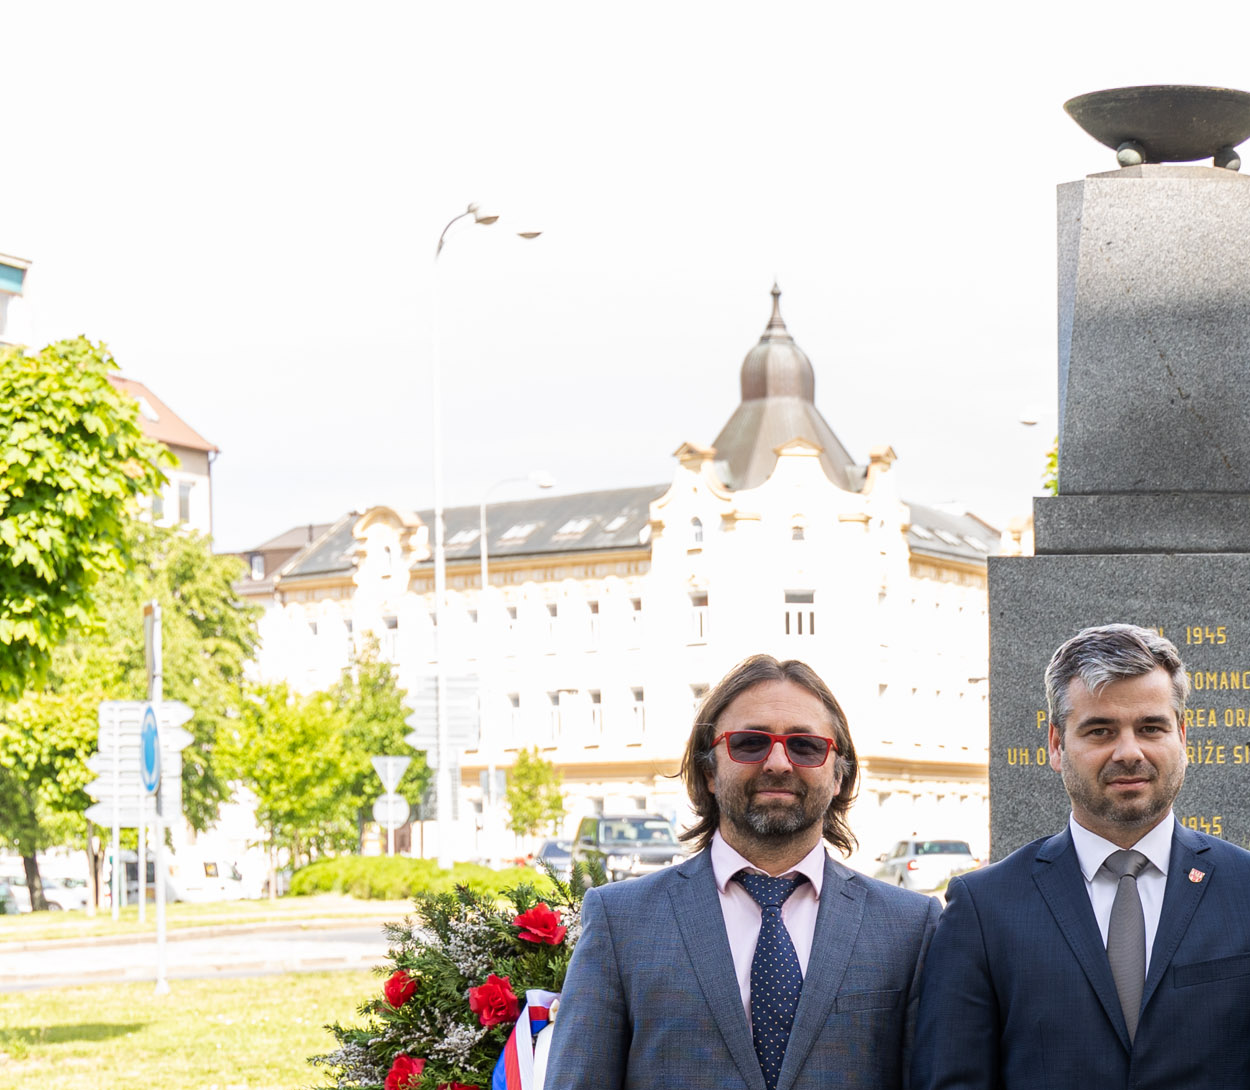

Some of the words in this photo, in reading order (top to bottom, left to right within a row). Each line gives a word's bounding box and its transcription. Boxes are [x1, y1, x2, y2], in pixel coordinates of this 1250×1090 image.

[1186, 626, 1227, 645] 1945
[1036, 710, 1047, 729] P
[1185, 708, 1217, 727] REA
[1007, 747, 1047, 766] UH.O
[1186, 739, 1226, 765] ŘÍŽE
[1233, 745, 1250, 764] SI
[1181, 815, 1223, 835] 1945
